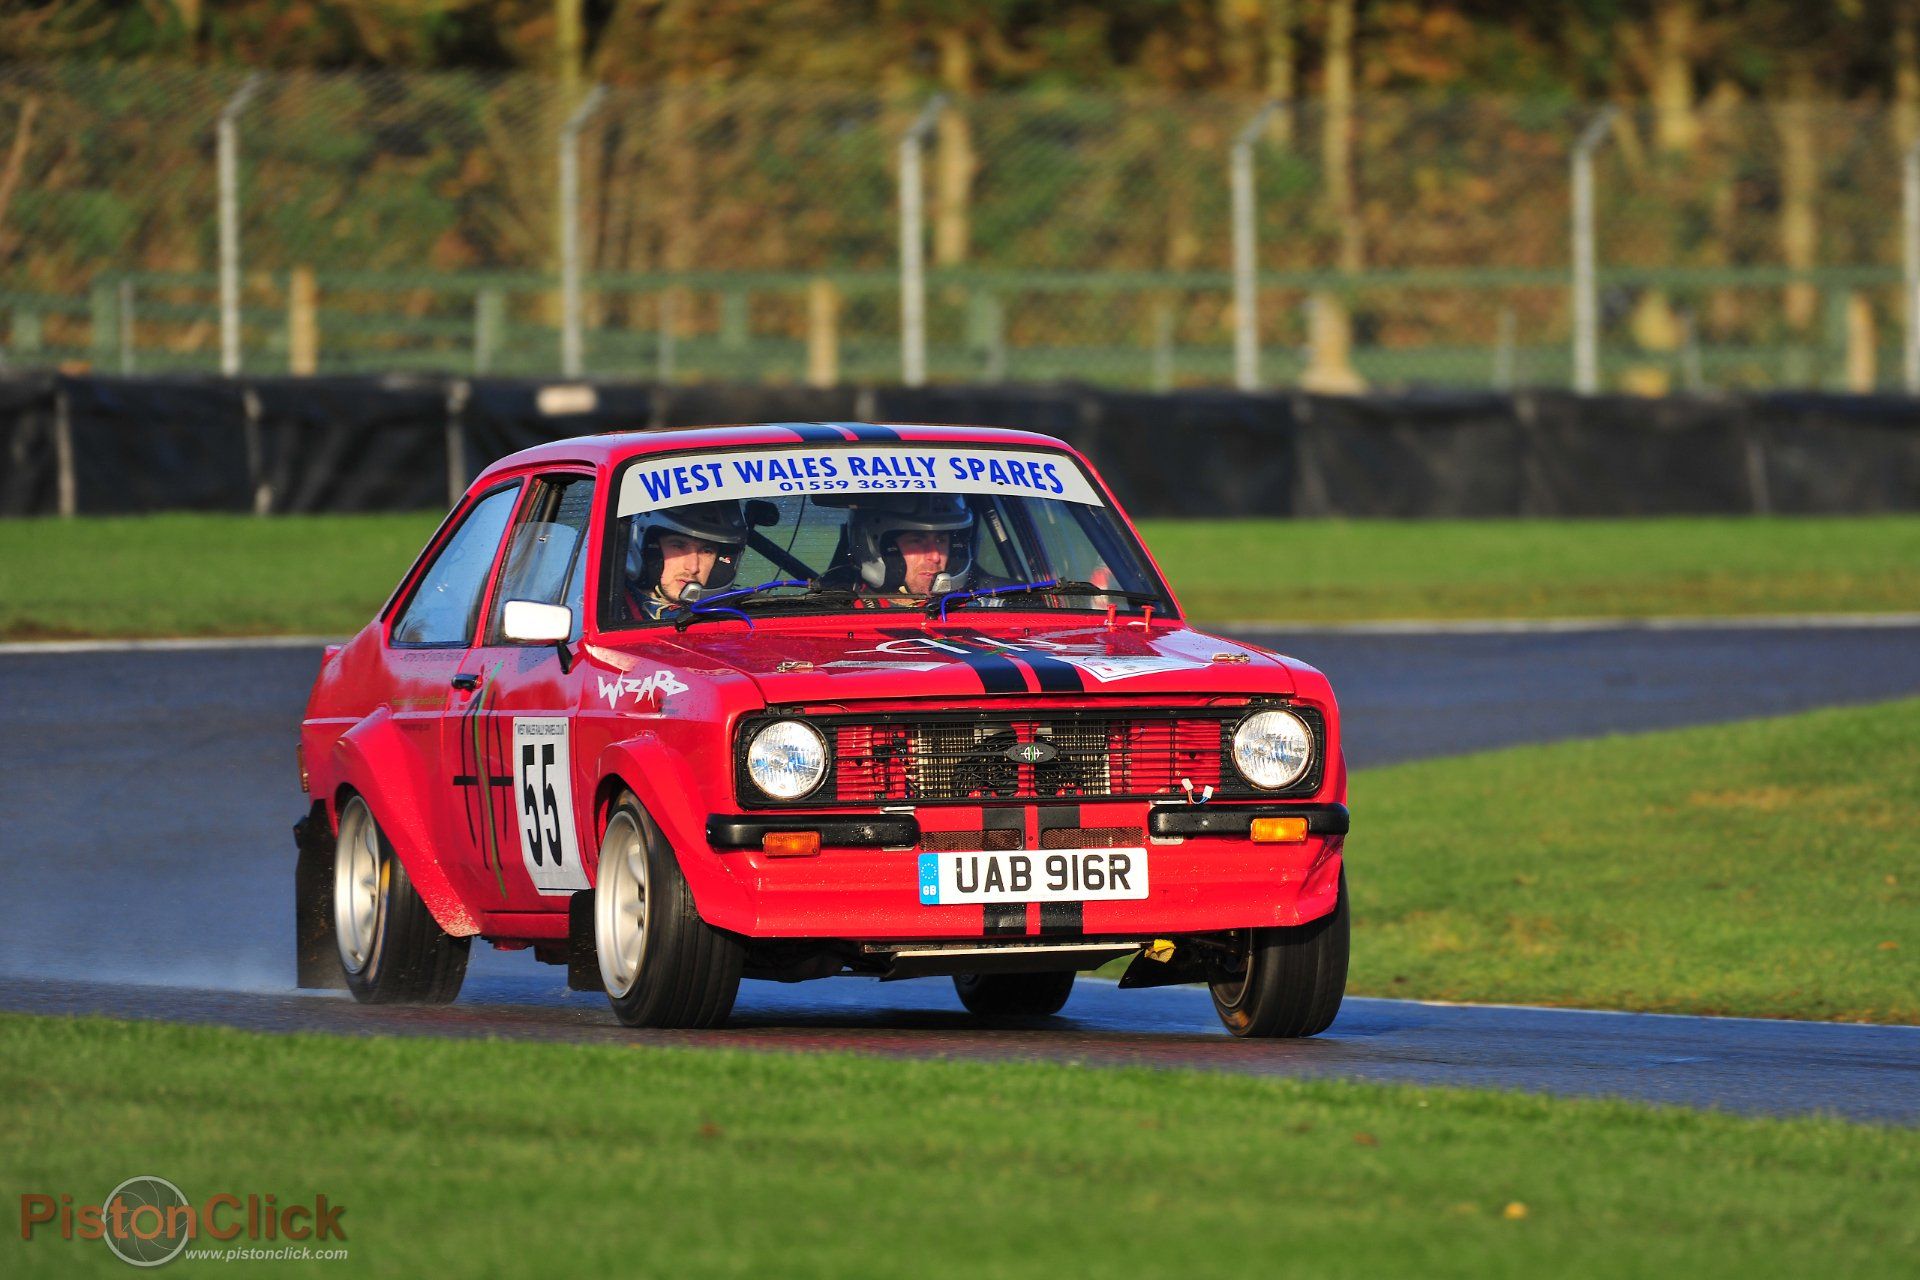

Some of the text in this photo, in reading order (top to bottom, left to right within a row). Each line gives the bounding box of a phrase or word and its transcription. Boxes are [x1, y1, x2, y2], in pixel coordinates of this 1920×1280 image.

[639, 456, 1064, 502] WEST WALES RALLY SPARES
[779, 479, 937, 492] 01559 363731
[597, 668, 690, 710] WIZARD
[522, 744, 562, 867] 55
[922, 884, 937, 896] GB
[955, 853, 1131, 893] UAB 916R
